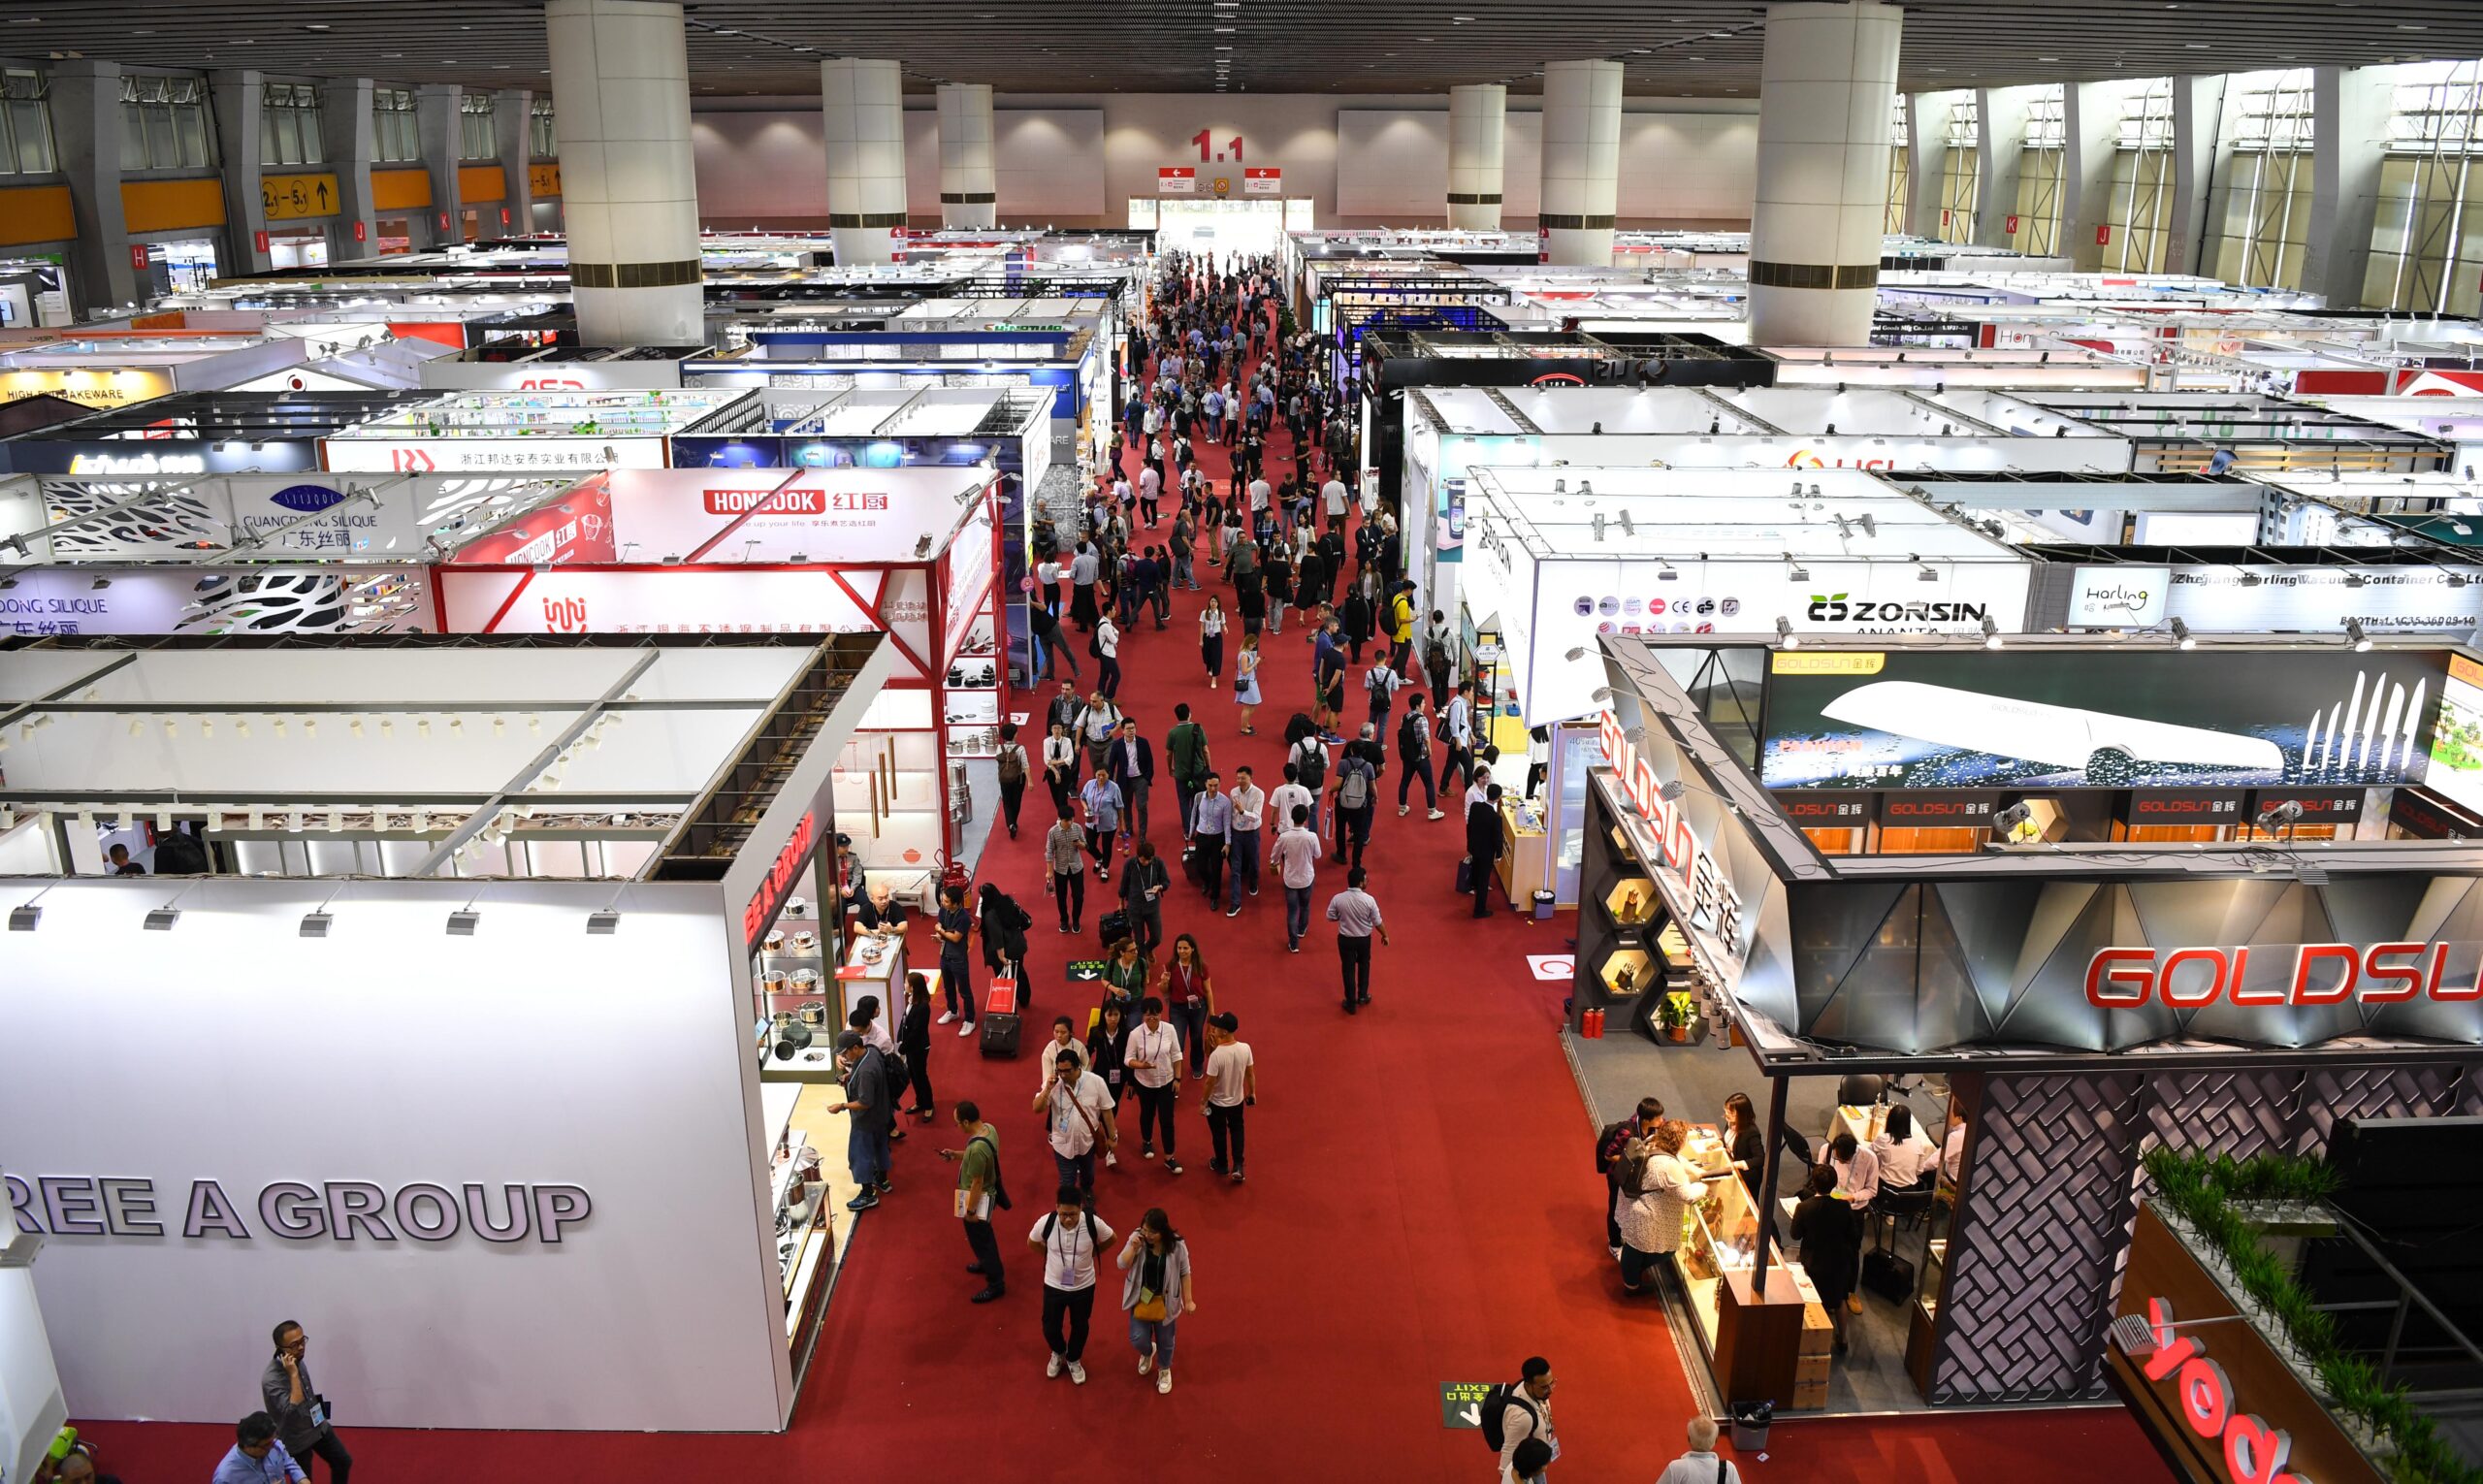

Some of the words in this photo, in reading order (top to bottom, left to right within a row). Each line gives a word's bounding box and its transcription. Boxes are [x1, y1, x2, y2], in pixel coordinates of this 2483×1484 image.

[1192, 129, 1242, 163] 1.1
[263, 191, 279, 208] 2.1
[292, 189, 308, 206] 5.1
[2008, 218, 2015, 232] K
[135, 248, 145, 267] H
[61, 389, 124, 401] BAKEWARE
[714, 492, 817, 511] HONCOOK
[832, 493, 887, 510] 红厨
[332, 515, 377, 529] SILIQUE
[281, 530, 351, 547] 广东丝丽
[2174, 573, 2239, 587] Zhejiang
[2298, 574, 2348, 585] Vacuu
[2363, 574, 2433, 586] Container
[2086, 584, 2151, 610] Harling
[48, 598, 109, 614] SILIQUE
[1672, 600, 1691, 614] CE
[1696, 599, 1715, 615] GS
[1853, 602, 1986, 622] ZONSIN
[1776, 659, 1851, 670] GOLDSUN
[1853, 659, 1877, 670] 金辉
[1838, 803, 1863, 815] 金辉
[1889, 803, 1965, 816] GOLDSUN
[1965, 803, 1990, 815] 金辉
[2139, 800, 2211, 813] GOLDSUN
[2211, 800, 2236, 813] 金辉
[2262, 799, 2333, 811] GODSUN
[2333, 798, 2357, 811] 金辉
[1600, 709, 1693, 889] GOLDSUN
[1695, 849, 1743, 955] 金辉
[774, 811, 814, 893] GROUP
[2083, 941, 2483, 1009] GOLDSU
[182, 1179, 253, 1241] A
[257, 1179, 593, 1244] GROUP
